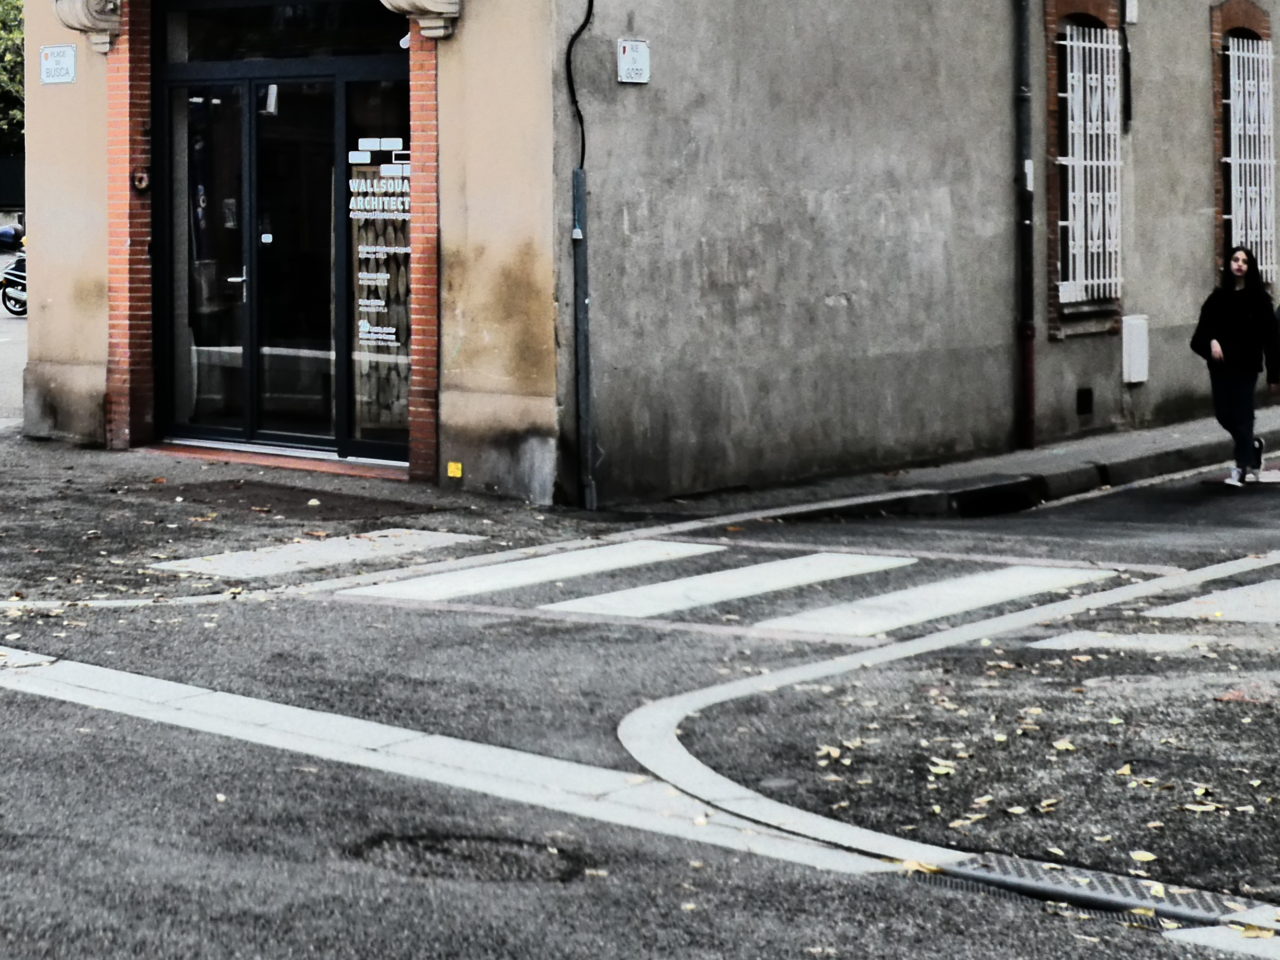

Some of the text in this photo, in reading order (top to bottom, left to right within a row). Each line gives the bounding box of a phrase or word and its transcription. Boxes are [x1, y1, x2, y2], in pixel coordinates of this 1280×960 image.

[45, 67, 71, 78] BUSCA
[349, 179, 410, 192] WALLSQUA
[349, 196, 410, 210] ARCHITECT
